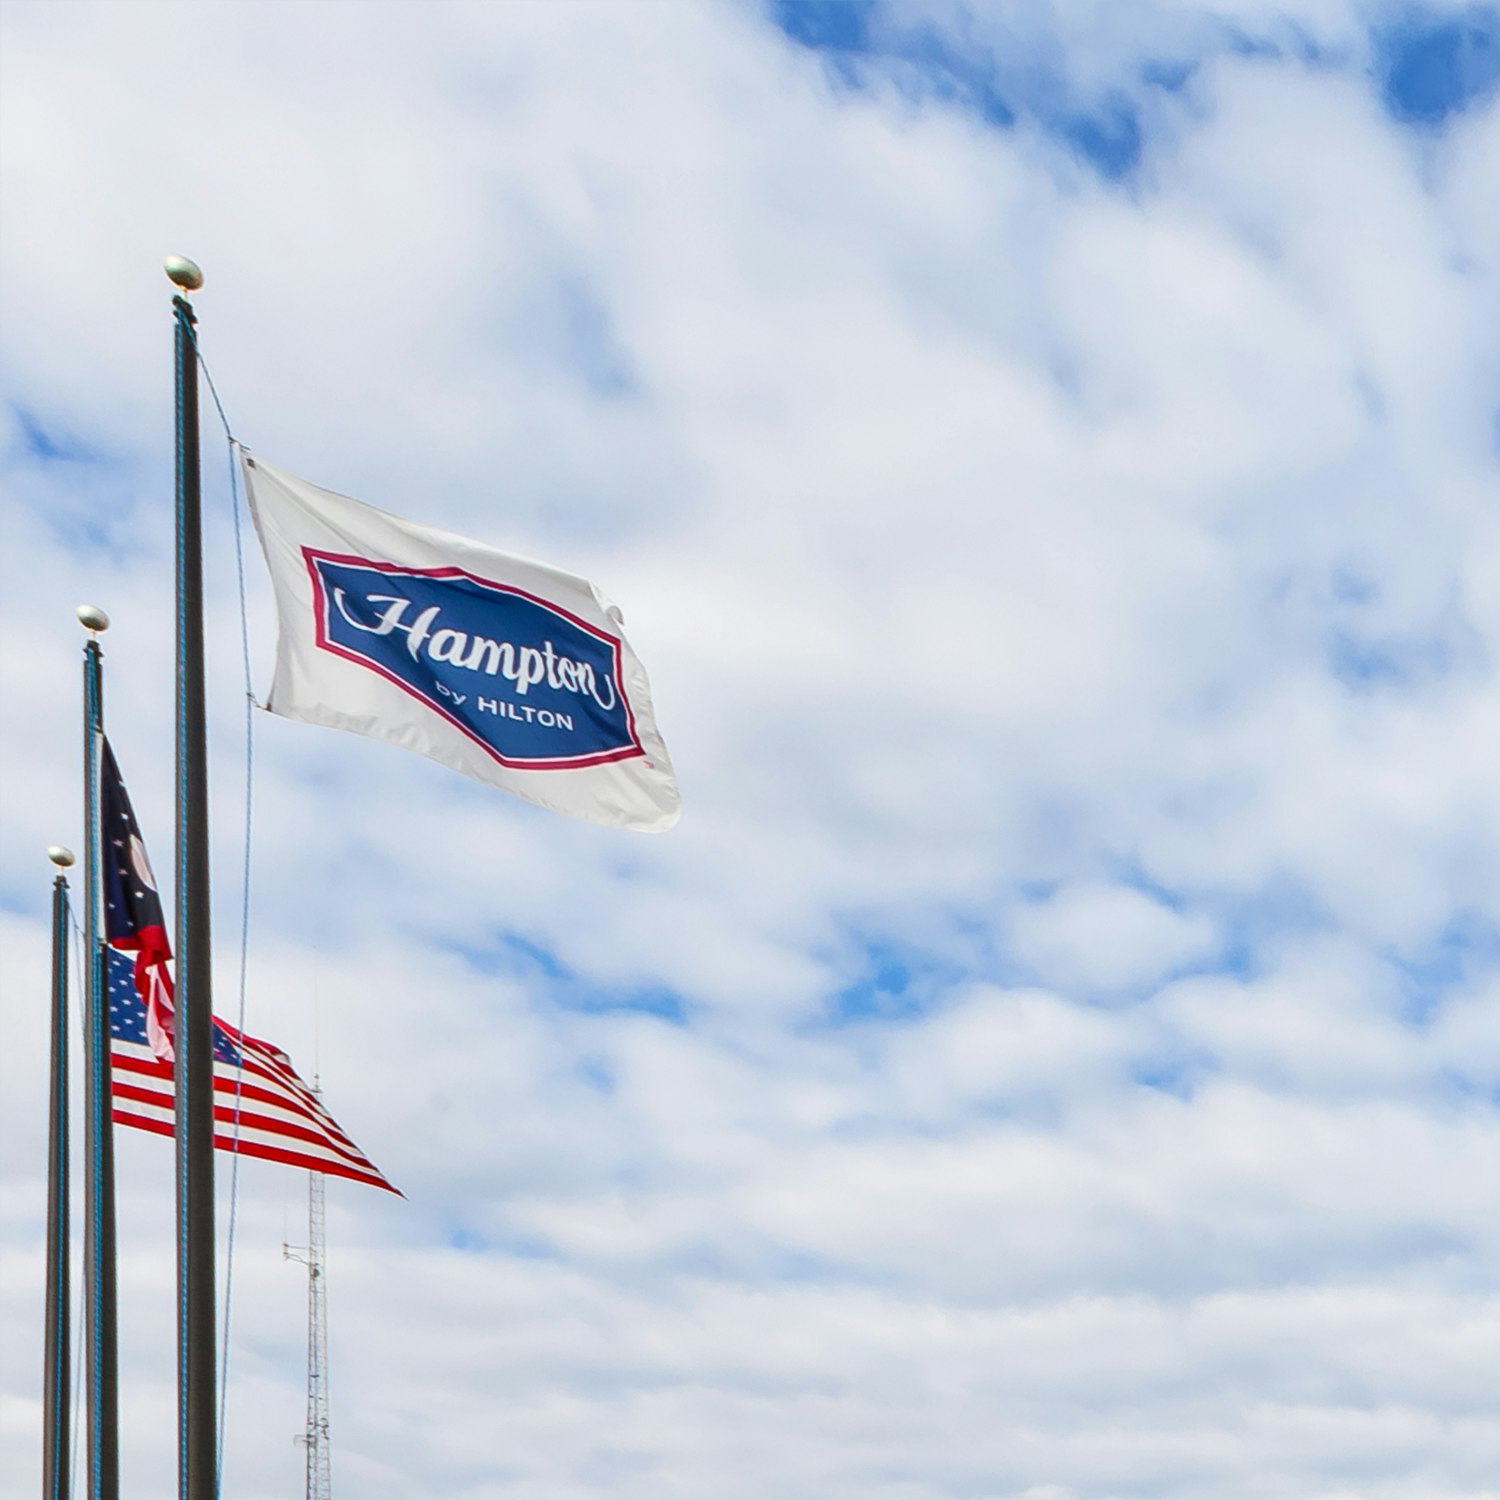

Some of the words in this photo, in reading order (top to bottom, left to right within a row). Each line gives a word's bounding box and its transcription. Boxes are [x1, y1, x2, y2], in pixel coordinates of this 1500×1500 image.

[334, 587, 616, 710] Hampton
[435, 681, 467, 705] by
[477, 695, 574, 733] HILTON
